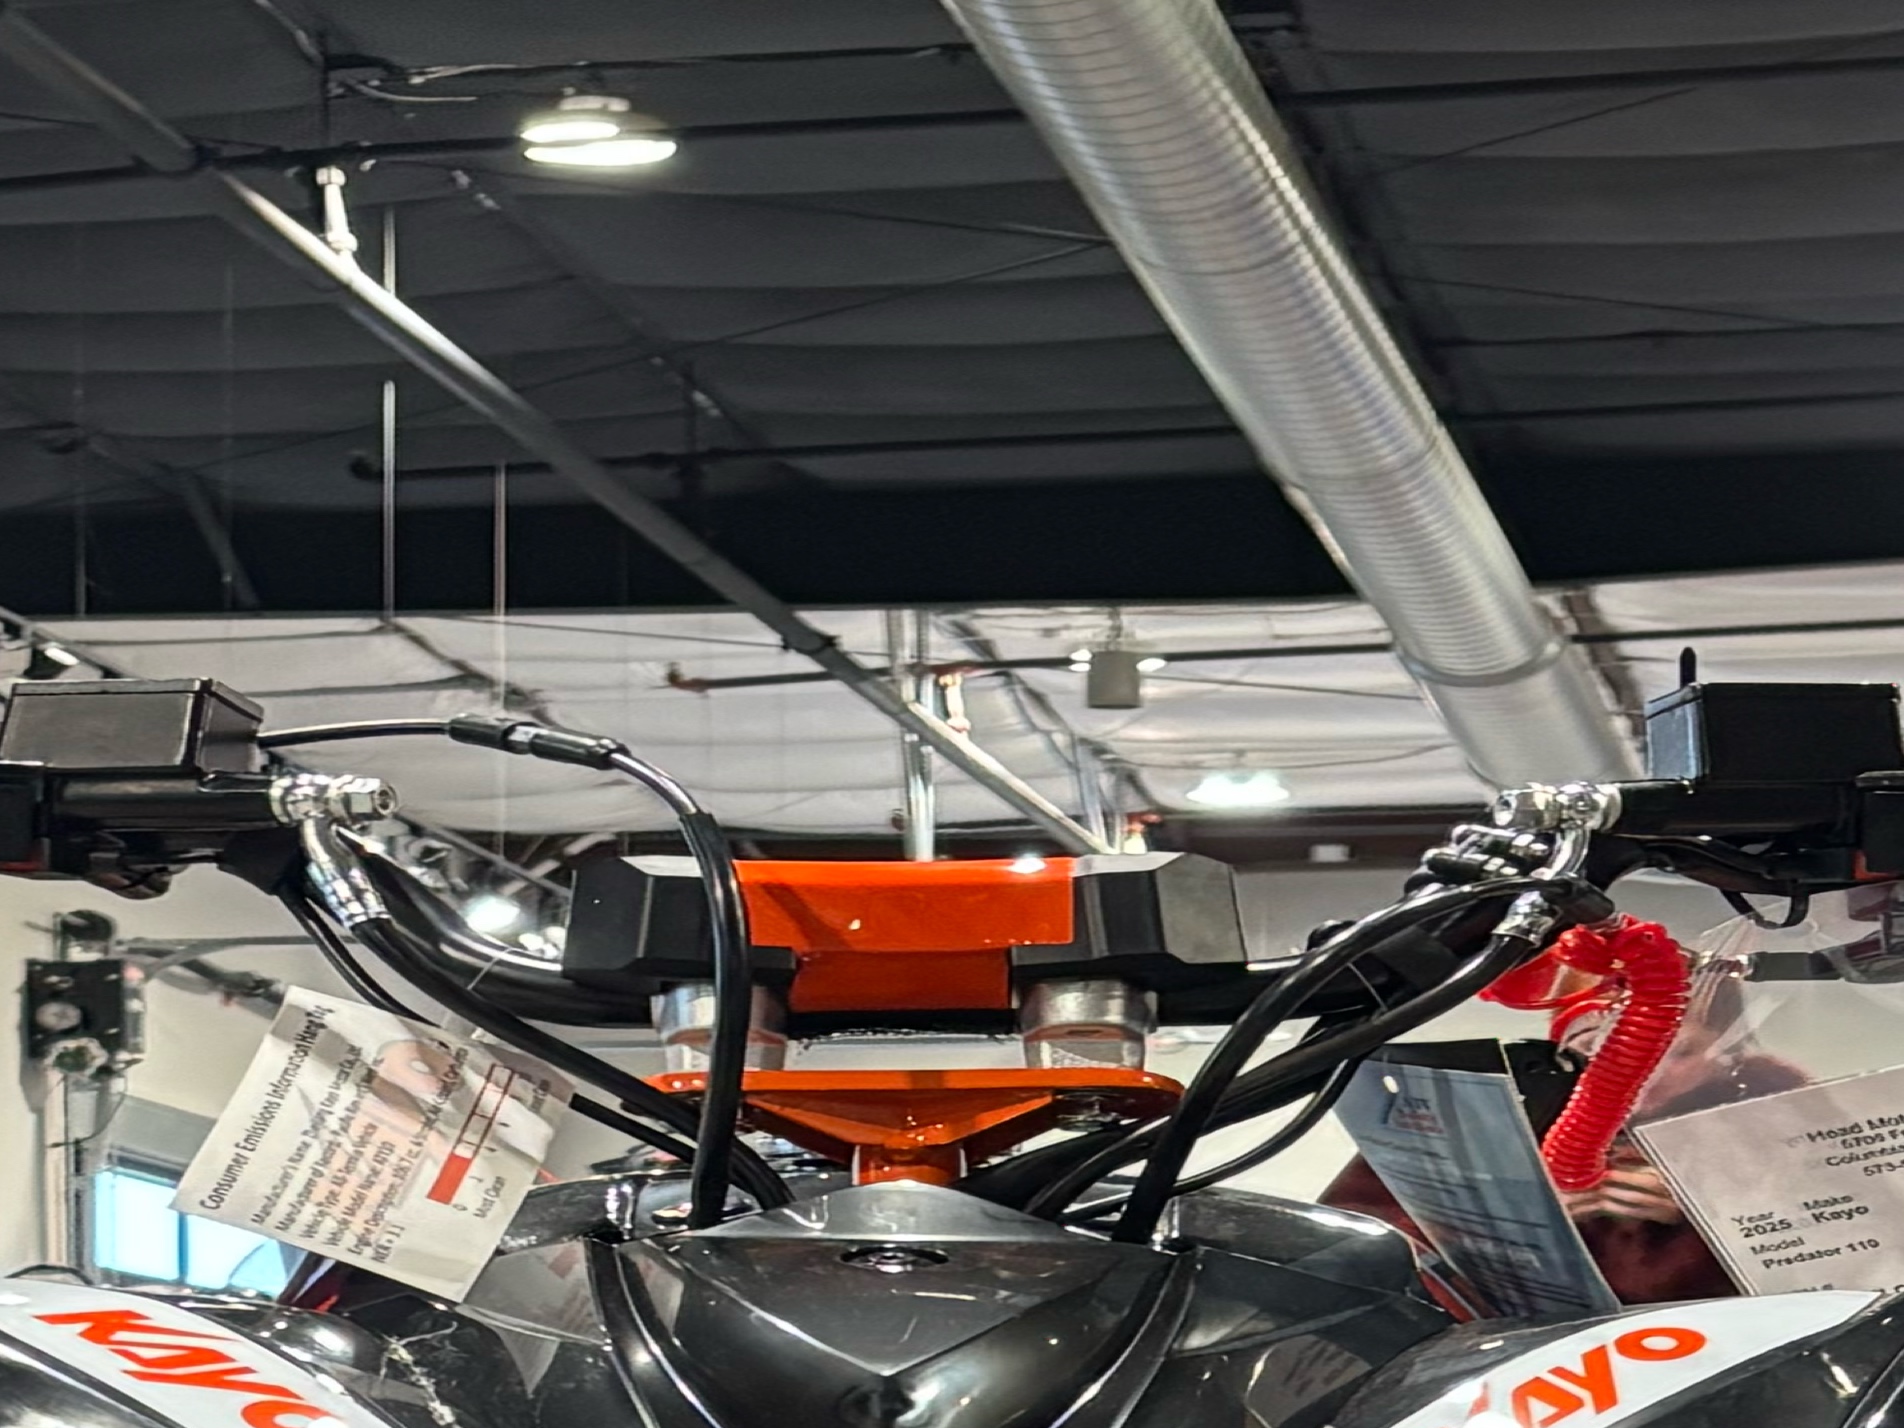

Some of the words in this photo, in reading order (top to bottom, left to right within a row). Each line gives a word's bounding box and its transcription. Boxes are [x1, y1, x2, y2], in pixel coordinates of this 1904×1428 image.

[199, 1150, 251, 1211] Consumer
[234, 1096, 283, 1152] Emissions
[264, 1041, 312, 1099] Information
[294, 1018, 329, 1050] Hang
[1731, 1211, 1775, 1226] Year
[1812, 1206, 1869, 1224] Kayo
[1740, 1218, 1793, 1239] 2025
[1750, 1236, 1806, 1255] Model
[1762, 1247, 1842, 1269] Predator
[1845, 1238, 1880, 1252] 110
